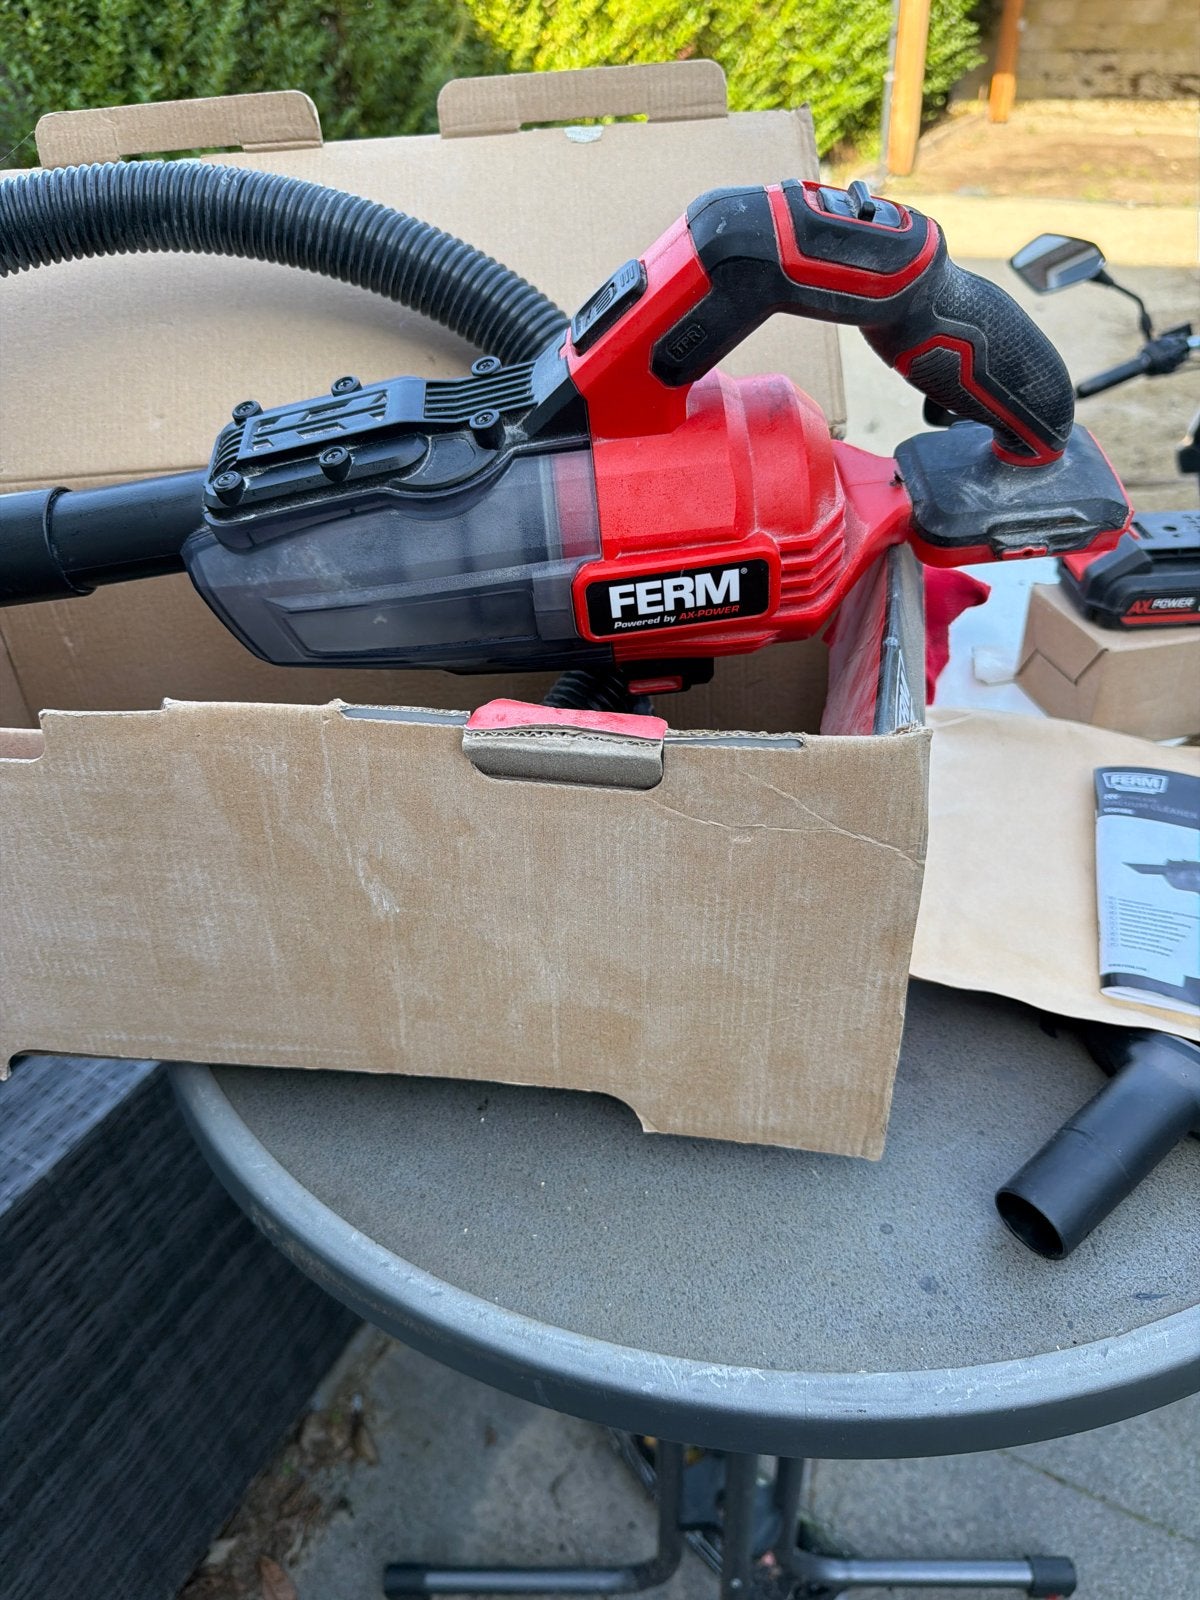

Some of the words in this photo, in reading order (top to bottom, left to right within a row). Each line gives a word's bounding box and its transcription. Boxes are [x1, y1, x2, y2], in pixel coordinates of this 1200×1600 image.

[672, 330, 701, 354] TPR
[614, 616, 661, 629] Powered
[663, 614, 677, 624] by
[679, 604, 740, 621] AX-POWER
[1110, 774, 1161, 789] FERM
